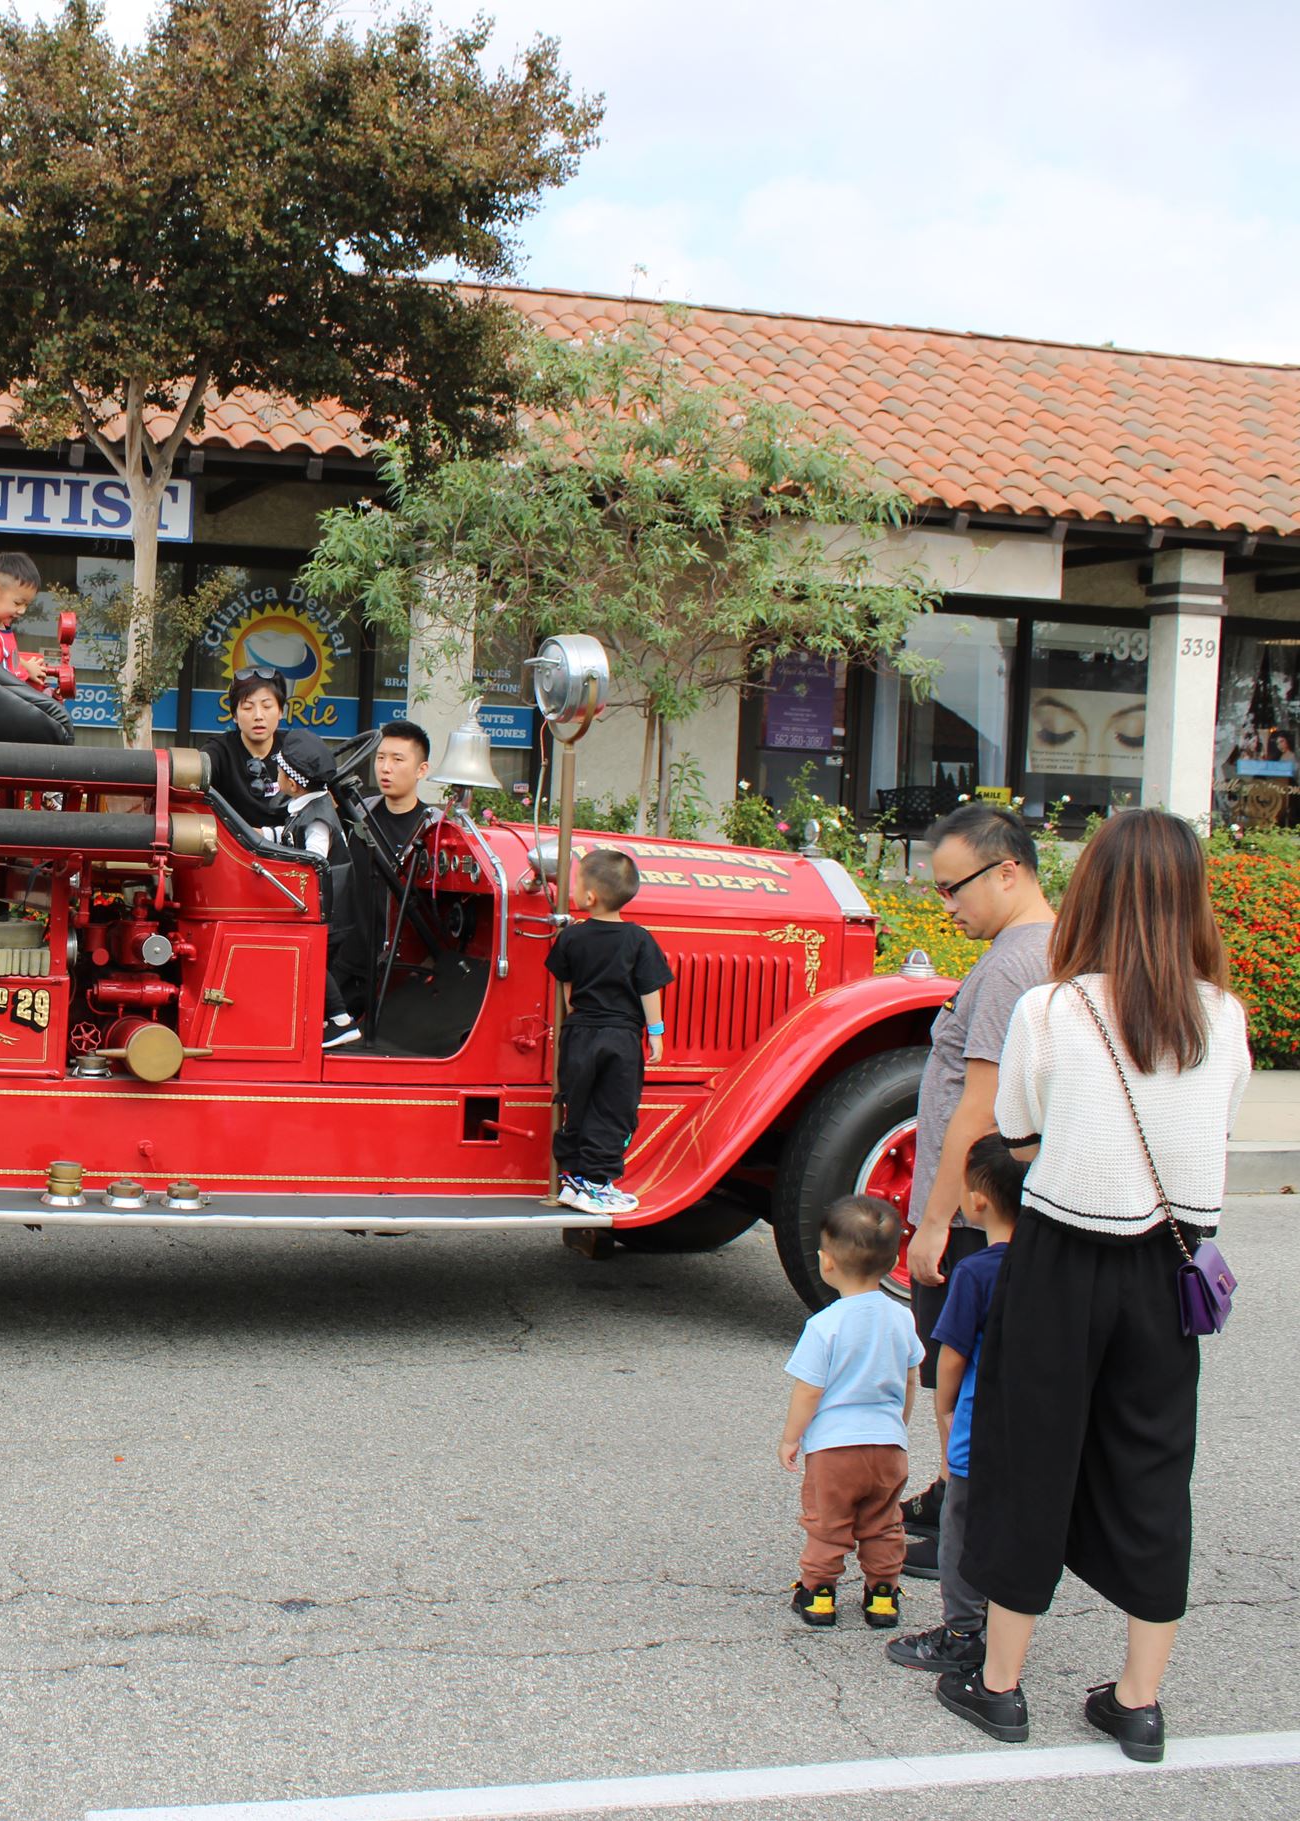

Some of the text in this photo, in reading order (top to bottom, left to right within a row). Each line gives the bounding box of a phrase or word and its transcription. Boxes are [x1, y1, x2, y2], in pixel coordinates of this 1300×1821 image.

[287, 584, 351, 657] Dental
[1112, 631, 1148, 662] 33
[1180, 638, 1215, 658] 339
[476, 713, 514, 724] ENTES
[484, 728, 527, 739] CIONES
[628, 843, 791, 877] HABRA
[639, 870, 789, 893] IRE DEPT.
[15, 988, 50, 1029] 29
